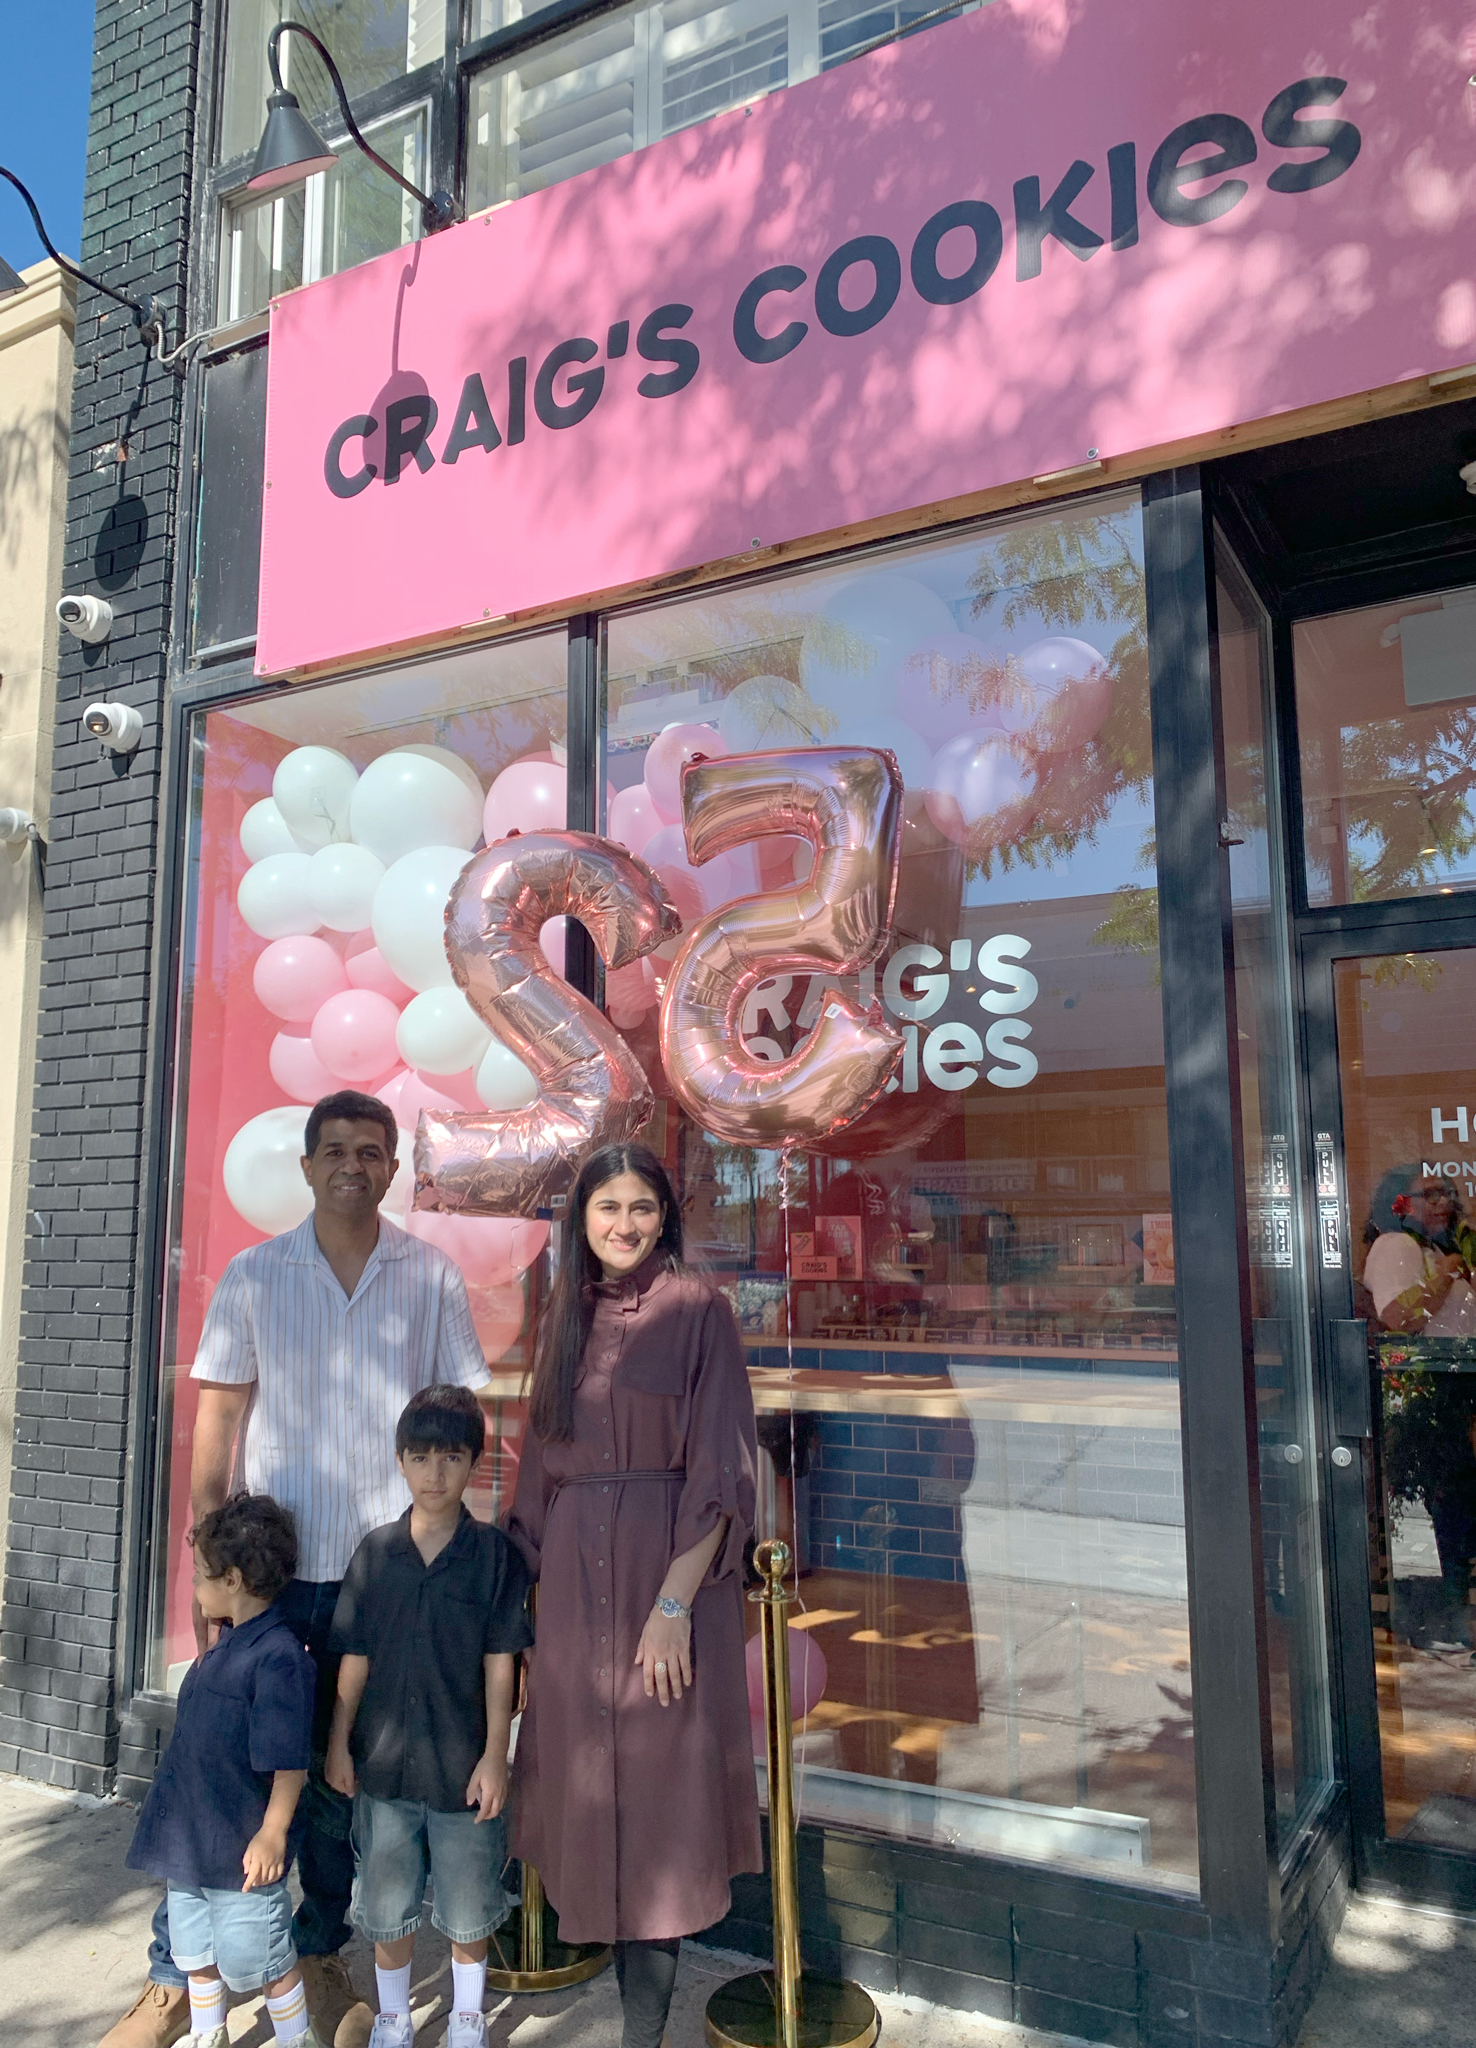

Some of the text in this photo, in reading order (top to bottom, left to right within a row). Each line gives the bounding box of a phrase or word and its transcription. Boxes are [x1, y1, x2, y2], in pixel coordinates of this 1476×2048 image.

[323, 303, 700, 499] CRAIG'S
[1430, 1106, 1476, 1143] H
[1321, 1151, 1331, 1186] PULL
[1327, 1220, 1336, 1252] PULL
